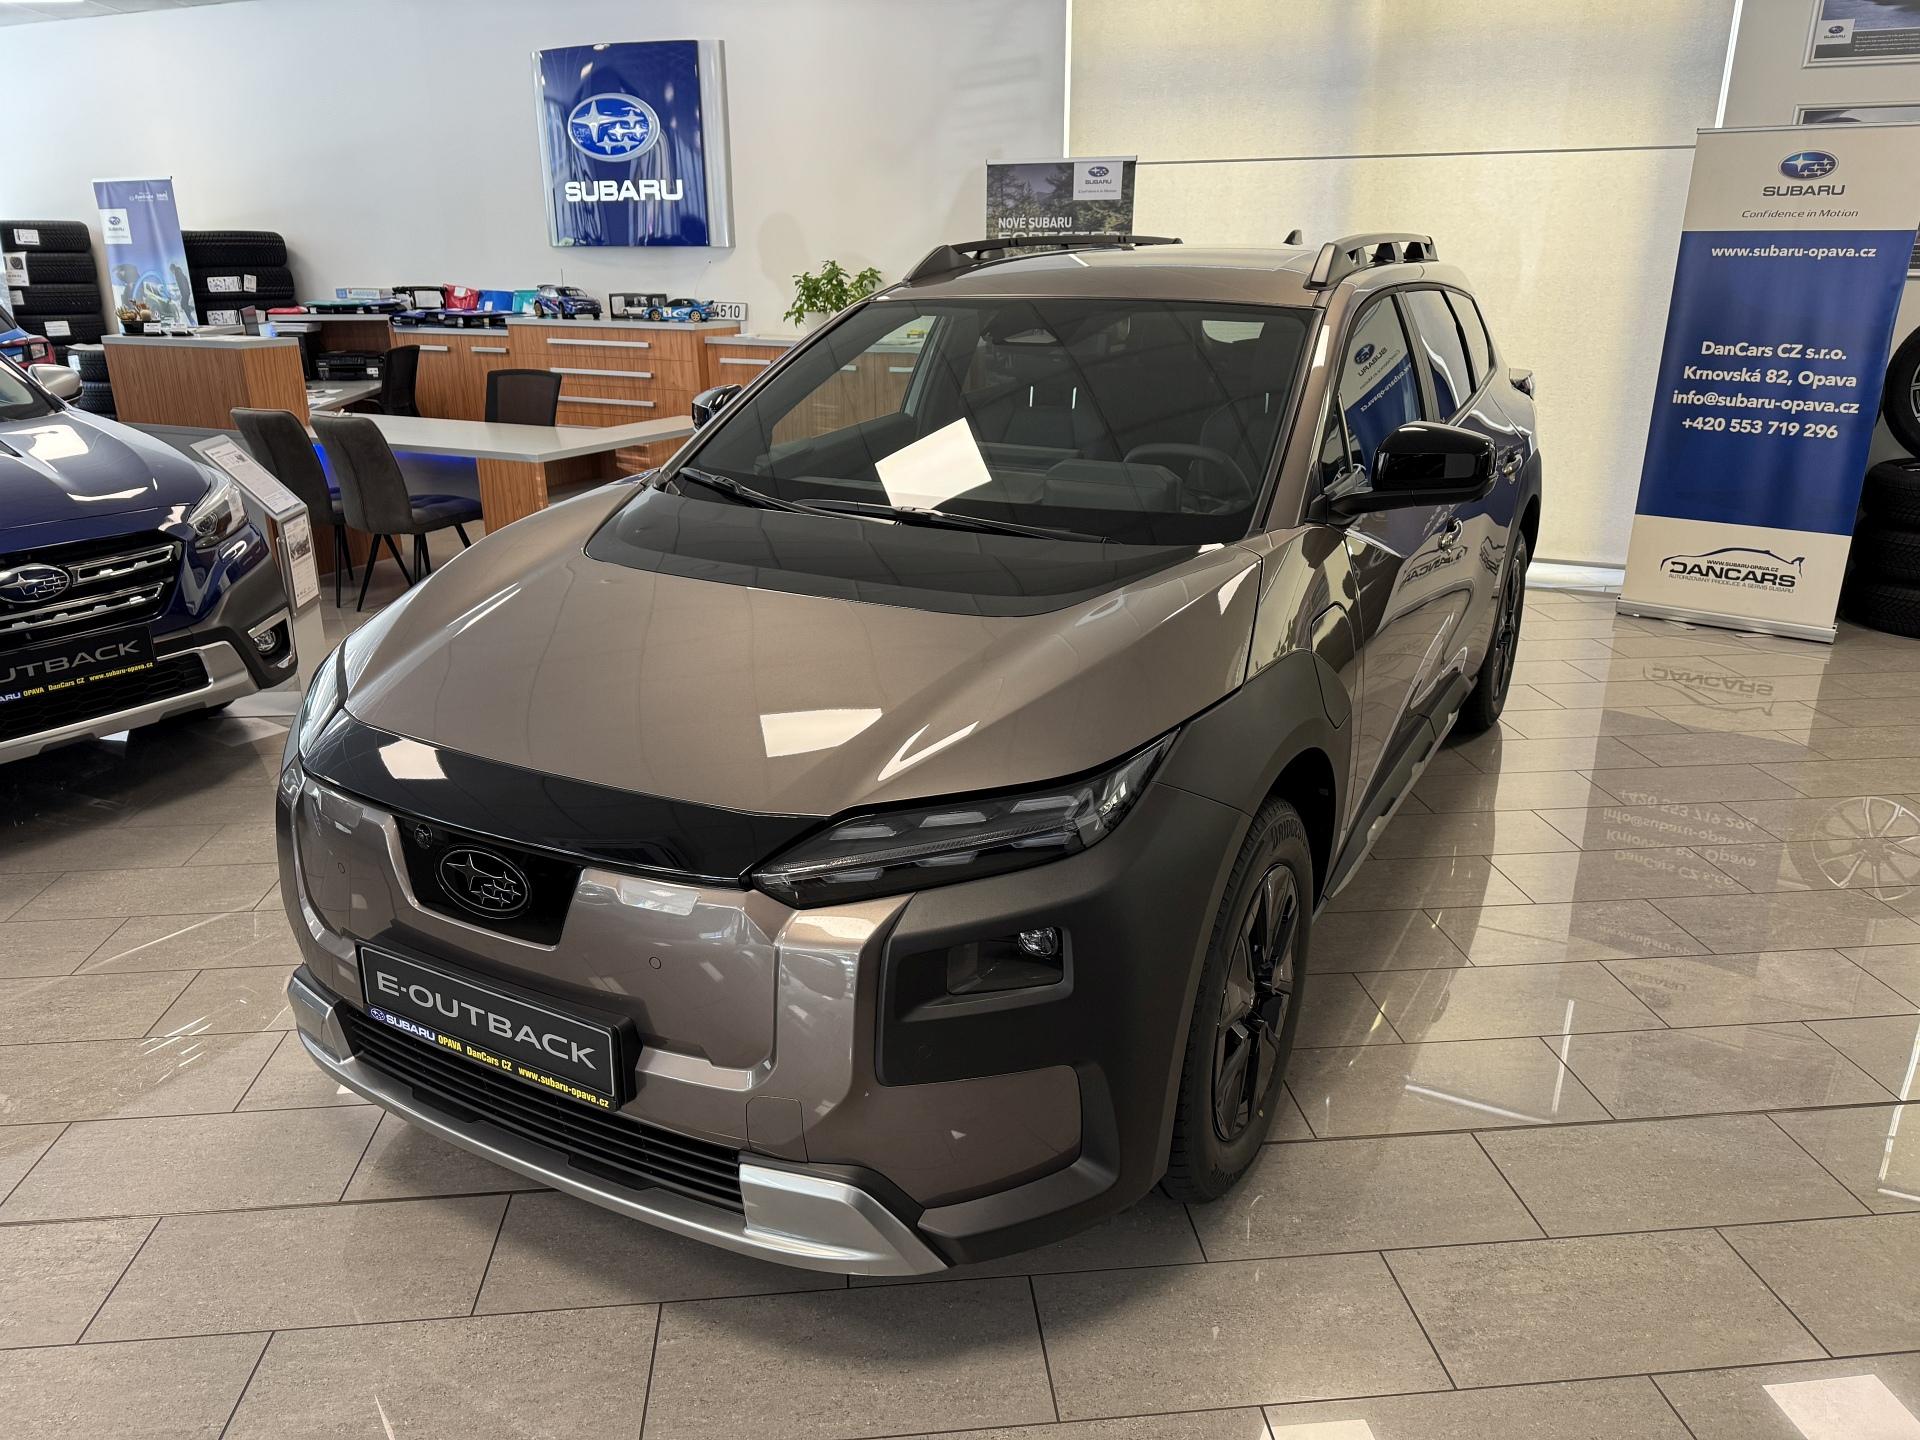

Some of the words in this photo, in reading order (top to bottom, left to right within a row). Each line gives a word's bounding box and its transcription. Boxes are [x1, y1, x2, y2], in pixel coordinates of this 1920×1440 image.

[564, 179, 684, 202] SUBARU
[1762, 185, 1846, 197] SUBARU
[998, 214, 1026, 229] NOVÉ
[1028, 216, 1073, 228] SUBARU
[1741, 209, 1805, 219] Confidence
[1806, 209, 1817, 218] in
[1818, 209, 1859, 218] Motion
[1711, 244, 1877, 260] www.subaru-opava.cz
[1701, 341, 1774, 358] DanCars
[1776, 344, 1803, 358] CZ
[1805, 347, 1847, 361] s.r.o.
[1683, 366, 1761, 383] Krnovská
[1765, 369, 1793, 386] 82,
[1797, 370, 1857, 389] Opava
[1672, 390, 1860, 415] info@subaru-opava.cz
[1681, 416, 1726, 432] +420
[1729, 418, 1763, 434] 553
[1767, 421, 1801, 436] 719
[1803, 423, 1839, 439] 296
[1669, 560, 1796, 588] DANCARS
[23, 686, 45, 697] OPAVA
[48, 679, 75, 691] DanCars
[76, 676, 86, 685] CZ
[89, 662, 154, 682] www.subaru-opava.cz
[377, 971, 598, 1071] E-OUTBACK
[386, 1014, 436, 1041] SUBARU
[438, 1034, 463, 1052] OPAVA
[466, 1045, 500, 1067] DanCars
[501, 1059, 513, 1072] CZ
[518, 1066, 610, 1108] www.subaru-opava.cz
